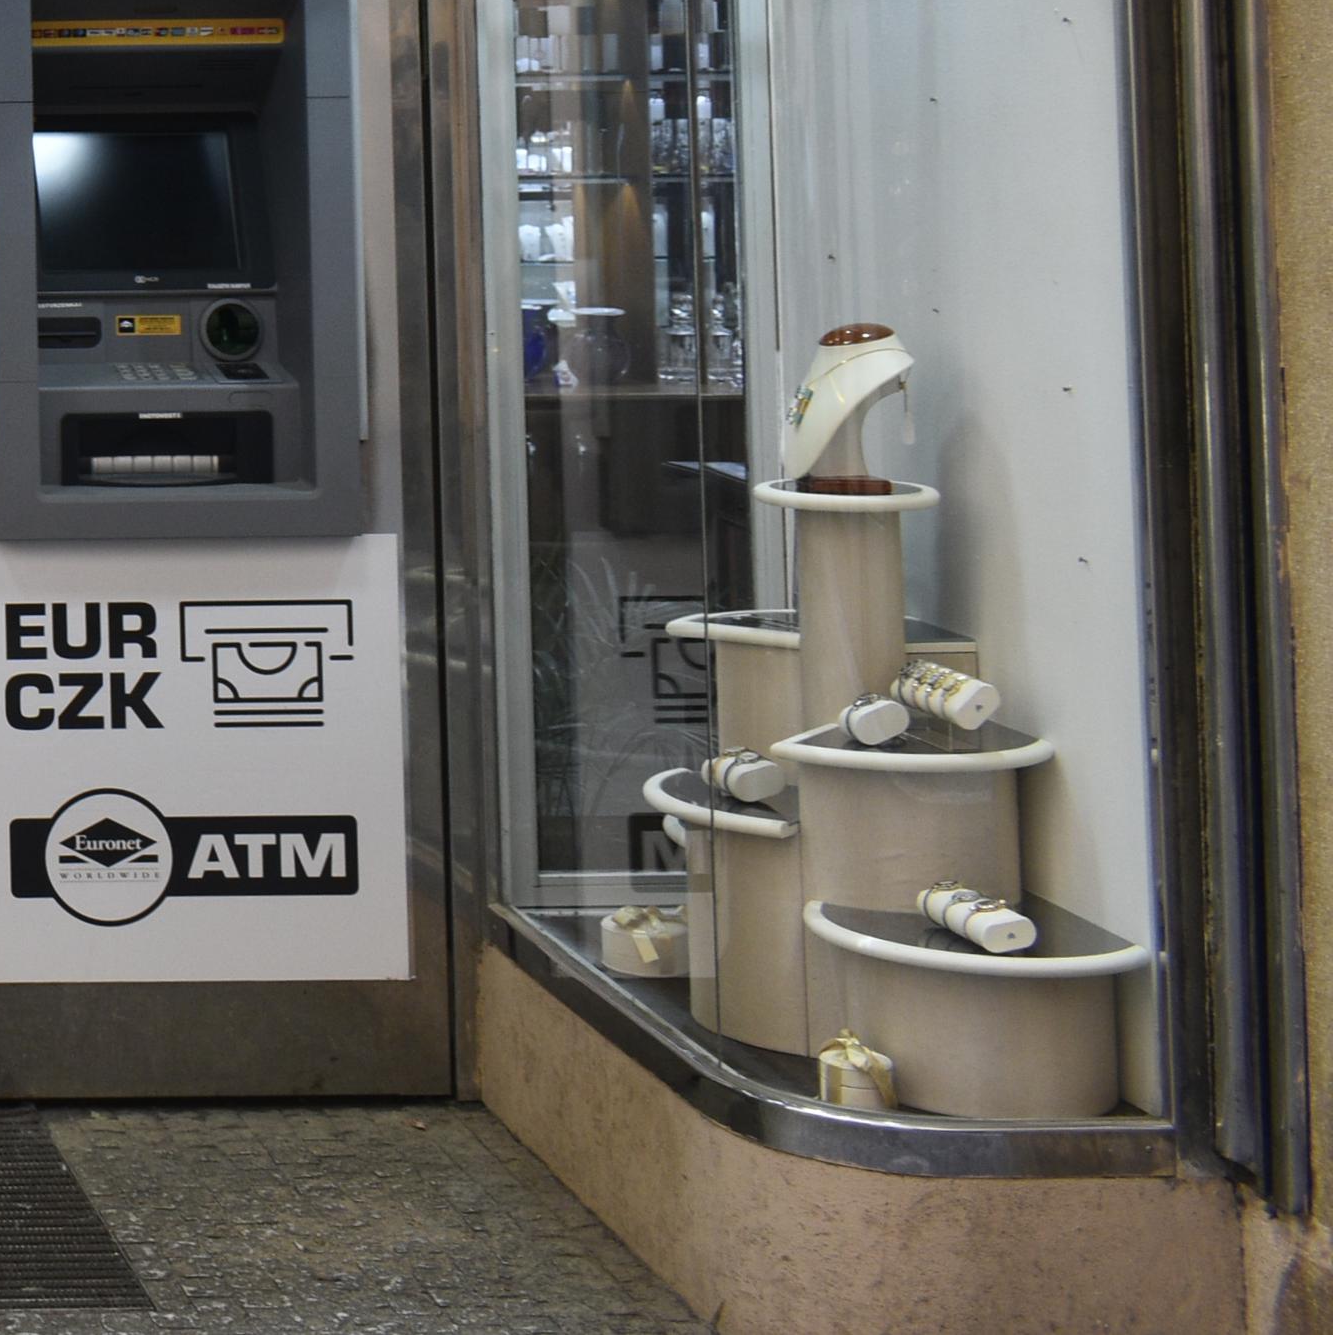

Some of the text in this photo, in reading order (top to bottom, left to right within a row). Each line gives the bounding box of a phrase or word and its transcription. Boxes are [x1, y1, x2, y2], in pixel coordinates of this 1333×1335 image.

[5, 602, 158, 660] EUR
[5, 671, 165, 731] CZK
[59, 871, 161, 880] WORLDWIDE
[74, 833, 347, 879] Euronet ATM
